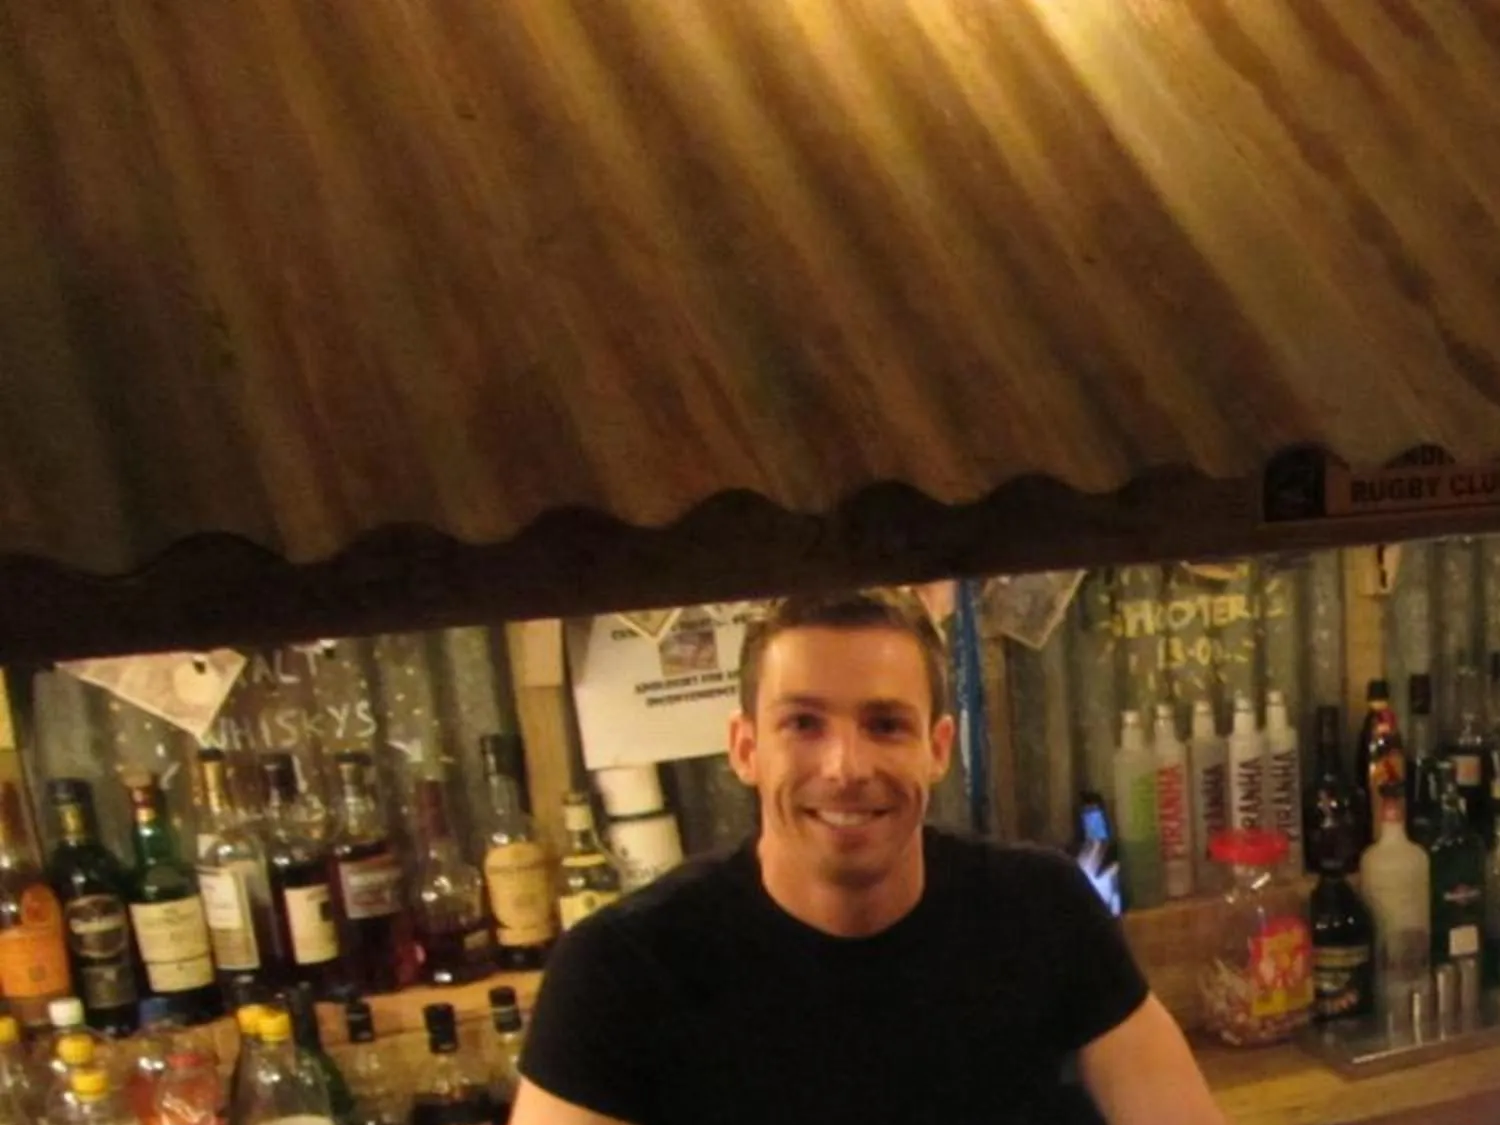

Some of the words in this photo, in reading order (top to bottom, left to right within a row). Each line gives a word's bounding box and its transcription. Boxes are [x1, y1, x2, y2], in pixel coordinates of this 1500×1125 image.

[1351, 475, 1441, 504] RUGBY
[238, 645, 322, 688] ALT
[1238, 756, 1264, 831] RANHA
